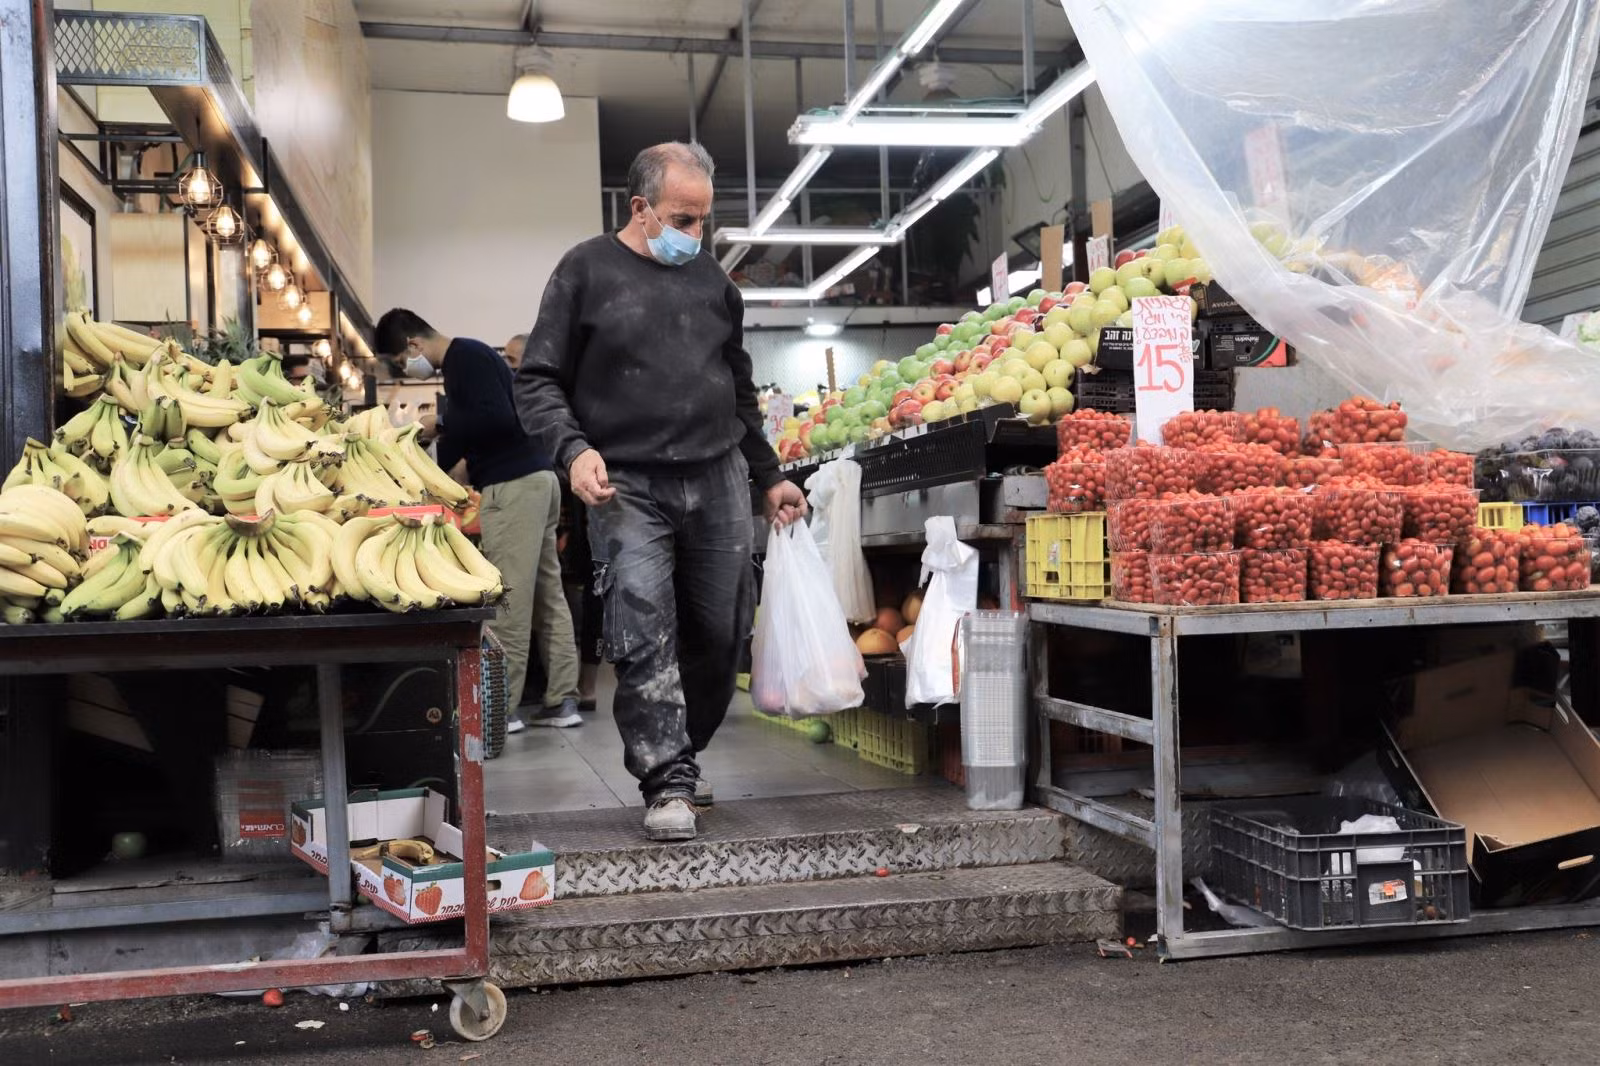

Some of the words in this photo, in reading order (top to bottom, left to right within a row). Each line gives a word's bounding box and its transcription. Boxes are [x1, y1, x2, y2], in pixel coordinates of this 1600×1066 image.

[1104, 330, 1120, 341] זהב
[1137, 343, 1184, 393] 15
[361, 879, 379, 894] תות
[497, 896, 518, 909] תות
